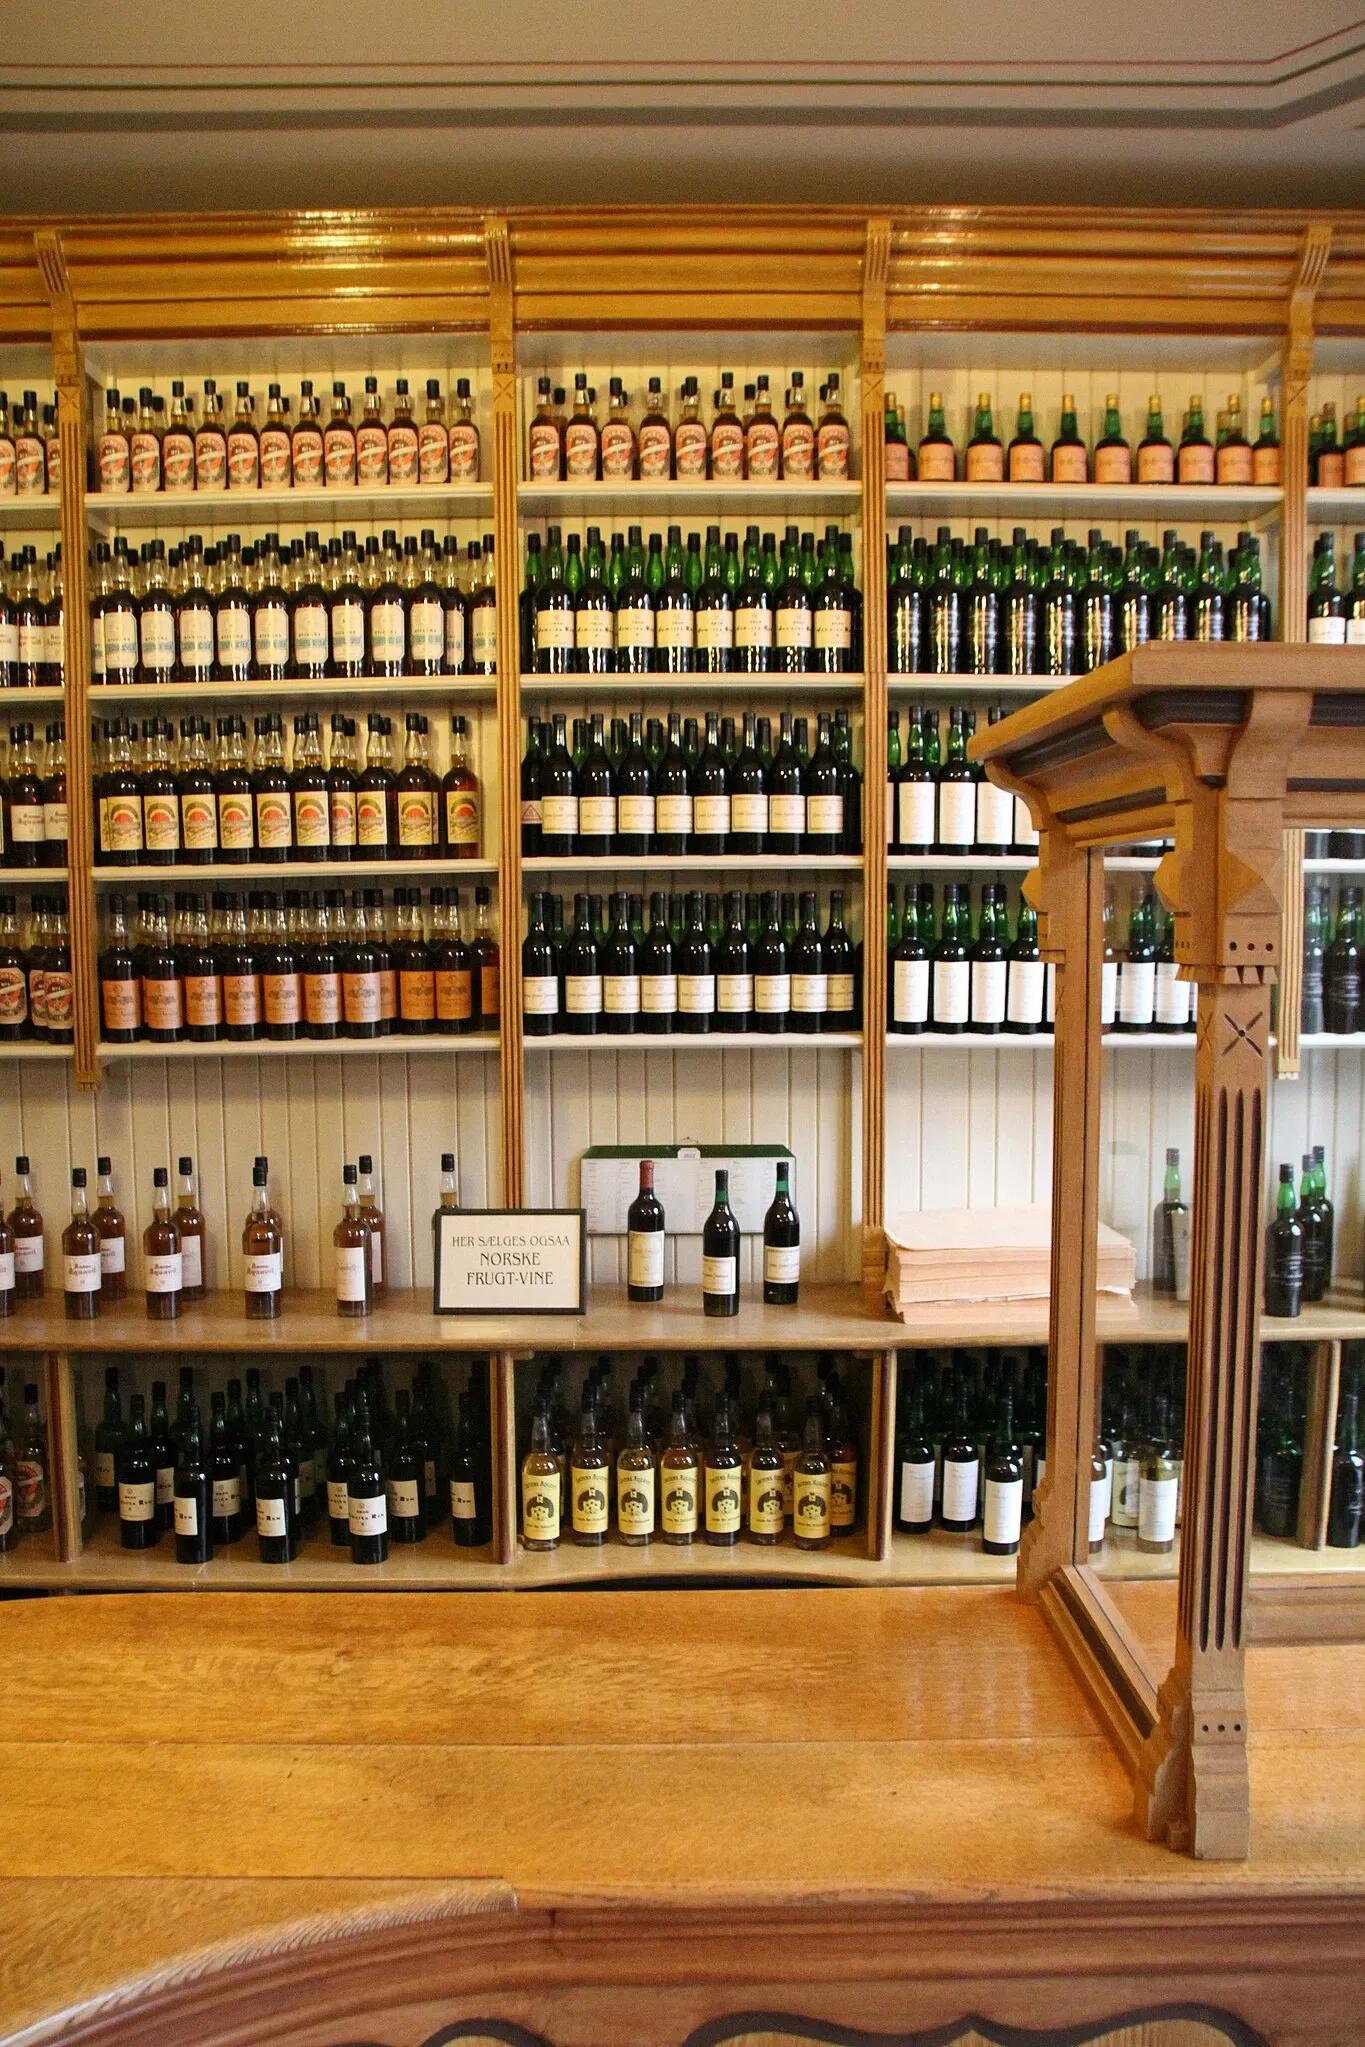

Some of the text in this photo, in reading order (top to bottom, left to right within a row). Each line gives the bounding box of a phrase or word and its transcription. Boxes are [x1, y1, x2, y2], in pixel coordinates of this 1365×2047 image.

[452, 1235, 570, 1247] HER SÆLGES OGSAA
[480, 1252, 540, 1266] NORSKE
[467, 1271, 554, 1286] FRUGT-VINE
